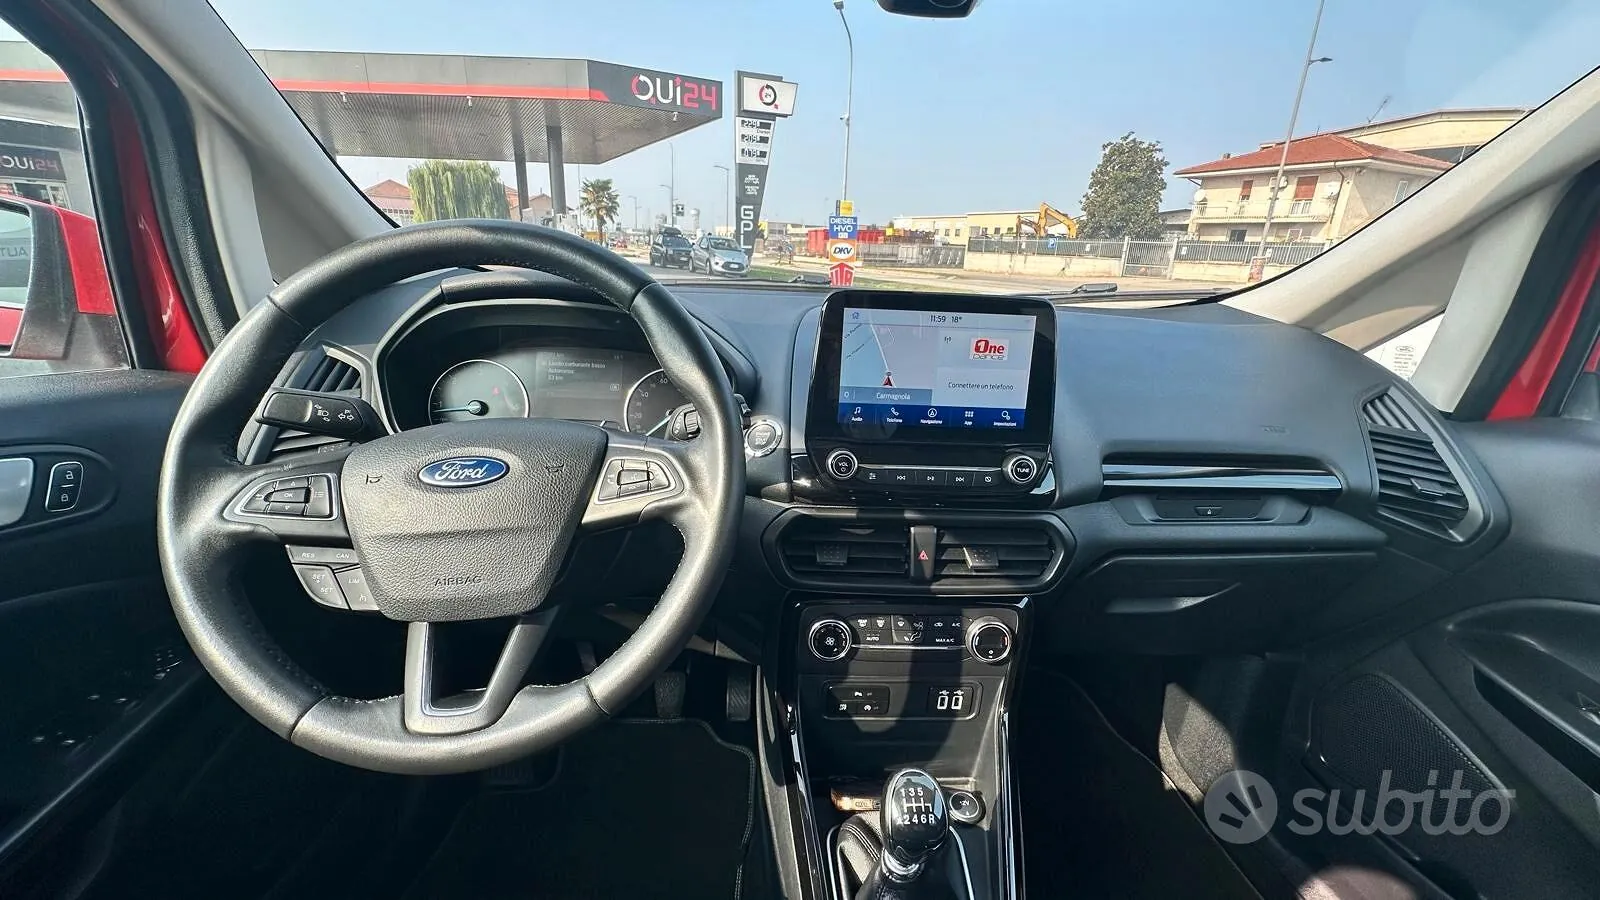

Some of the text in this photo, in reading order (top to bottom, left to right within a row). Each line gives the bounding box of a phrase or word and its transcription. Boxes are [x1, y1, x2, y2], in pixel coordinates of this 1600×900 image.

[830, 217, 857, 225] DIESEL
[741, 205, 754, 249] GPL
[833, 225, 853, 233] HVO
[833, 247, 853, 255] DKV
[930, 315, 946, 323] 11:59
[974, 339, 1005, 354] One
[990, 382, 1014, 390] telefono
[876, 392, 911, 400] Carmagnola
[434, 460, 490, 481] Ford
[434, 576, 482, 587] AIRBAG
[909, 788, 916, 797] 3
[917, 788, 924, 797] 5
[903, 814, 936, 824] 2 4 6 R
